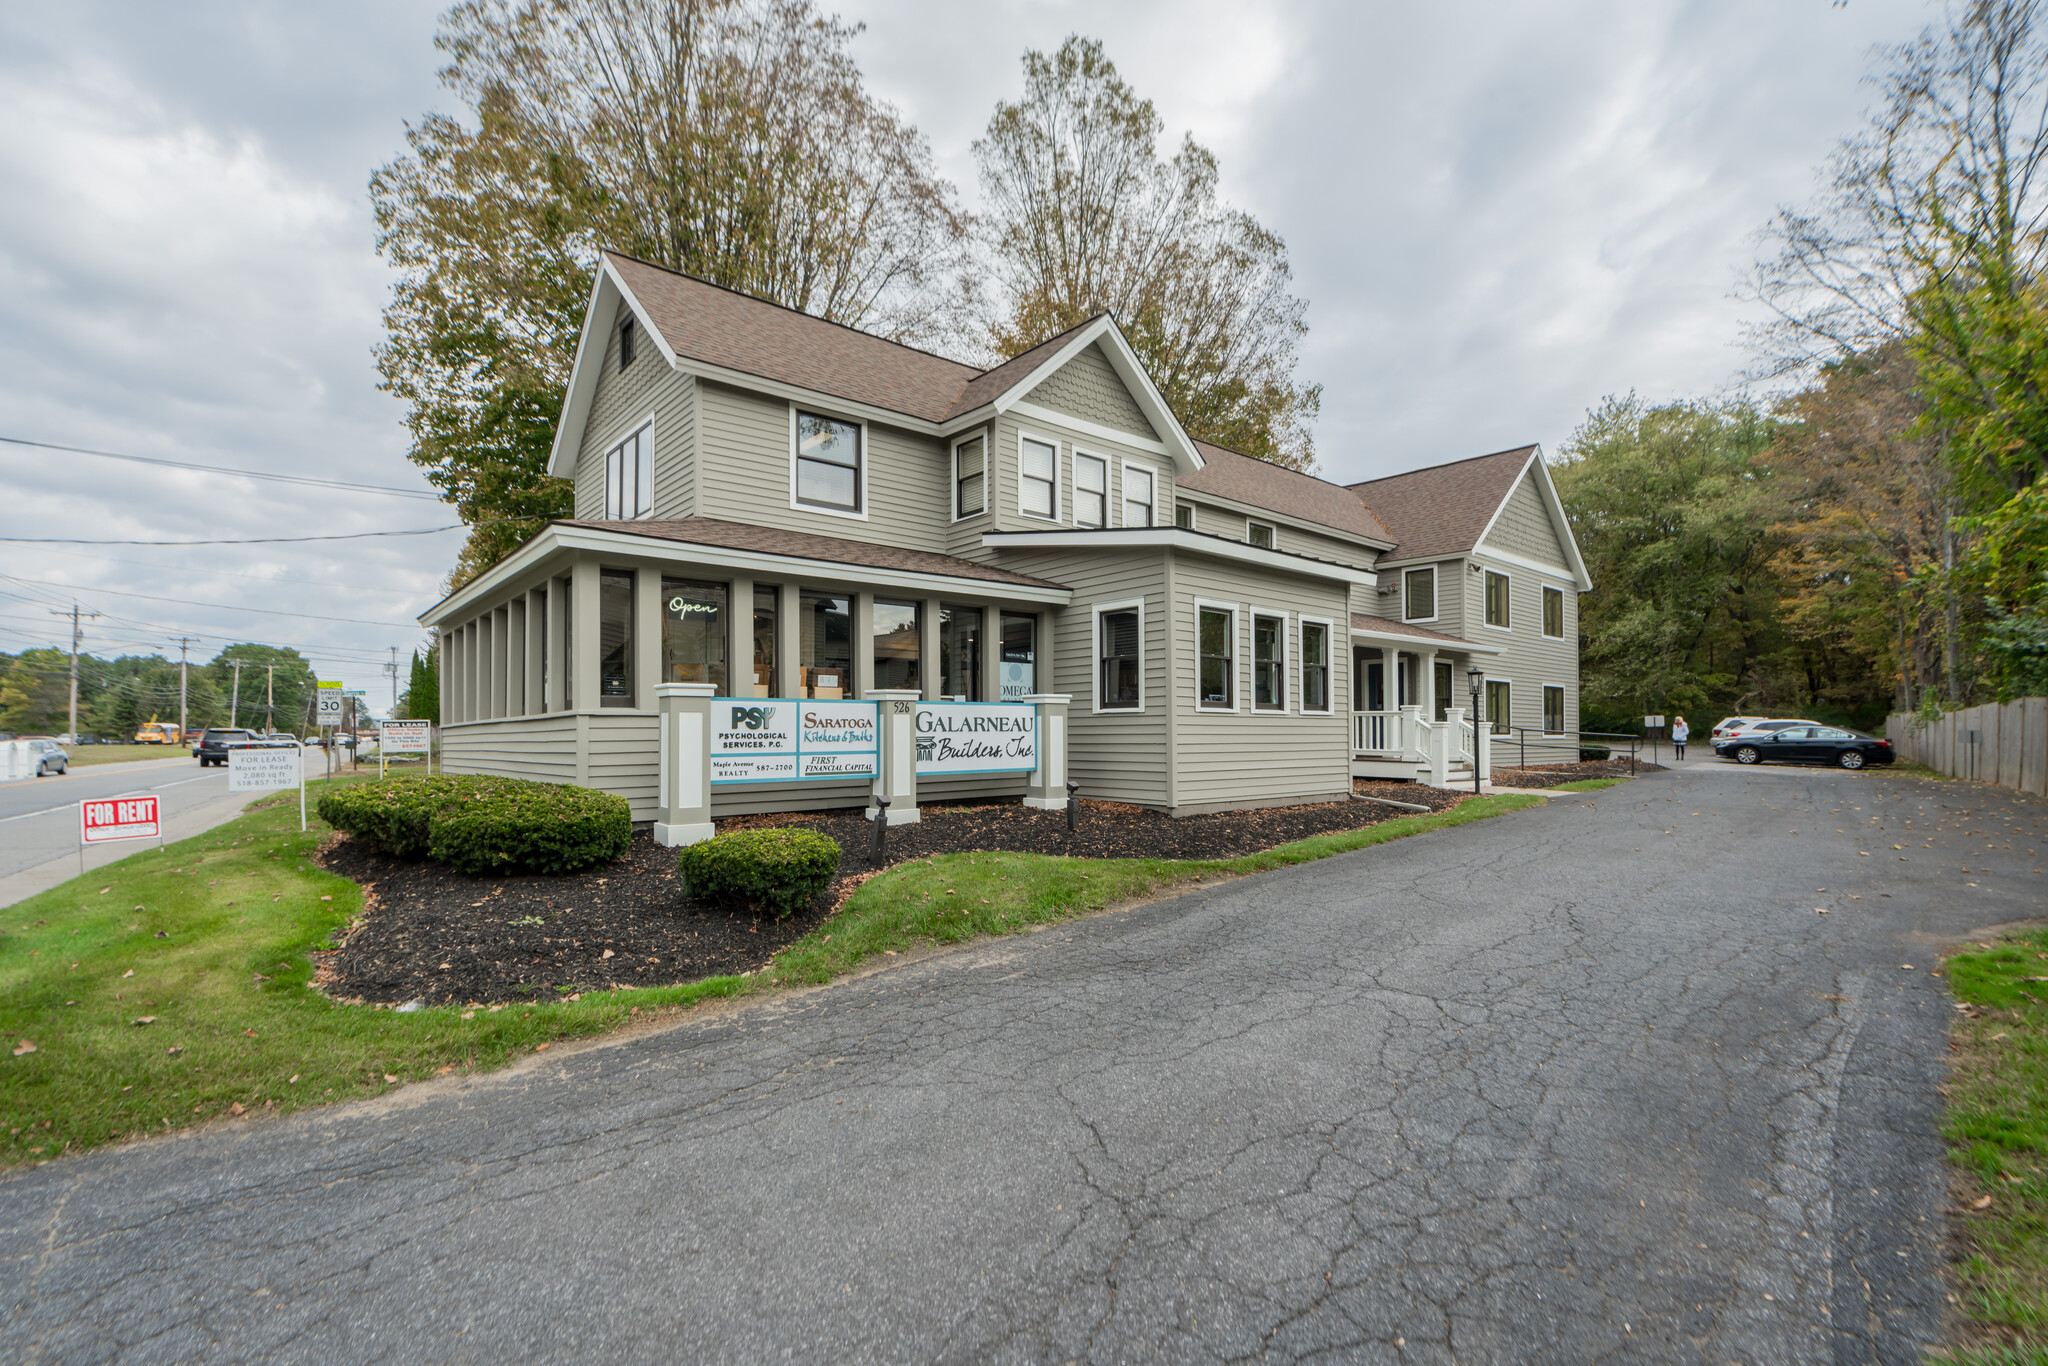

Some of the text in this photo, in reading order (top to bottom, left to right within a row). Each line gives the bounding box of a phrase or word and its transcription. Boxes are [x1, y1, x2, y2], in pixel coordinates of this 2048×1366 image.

[669, 596, 718, 620] Open
[320, 701, 340, 711] 30
[894, 701, 910, 713] 526
[804, 712, 873, 729] SARATOGA
[916, 711, 1034, 733] GALARNEAU
[718, 732, 787, 740] PSYCHOLOGICAL
[804, 729, 873, 743] Kitchens & Baths
[938, 736, 1034, 761] Builders, Inc.
[810, 756, 837, 765] FIRST
[756, 764, 793, 772] 587-2700
[805, 764, 843, 772] FINANCIAL
[86, 800, 155, 826] FOR RENT
